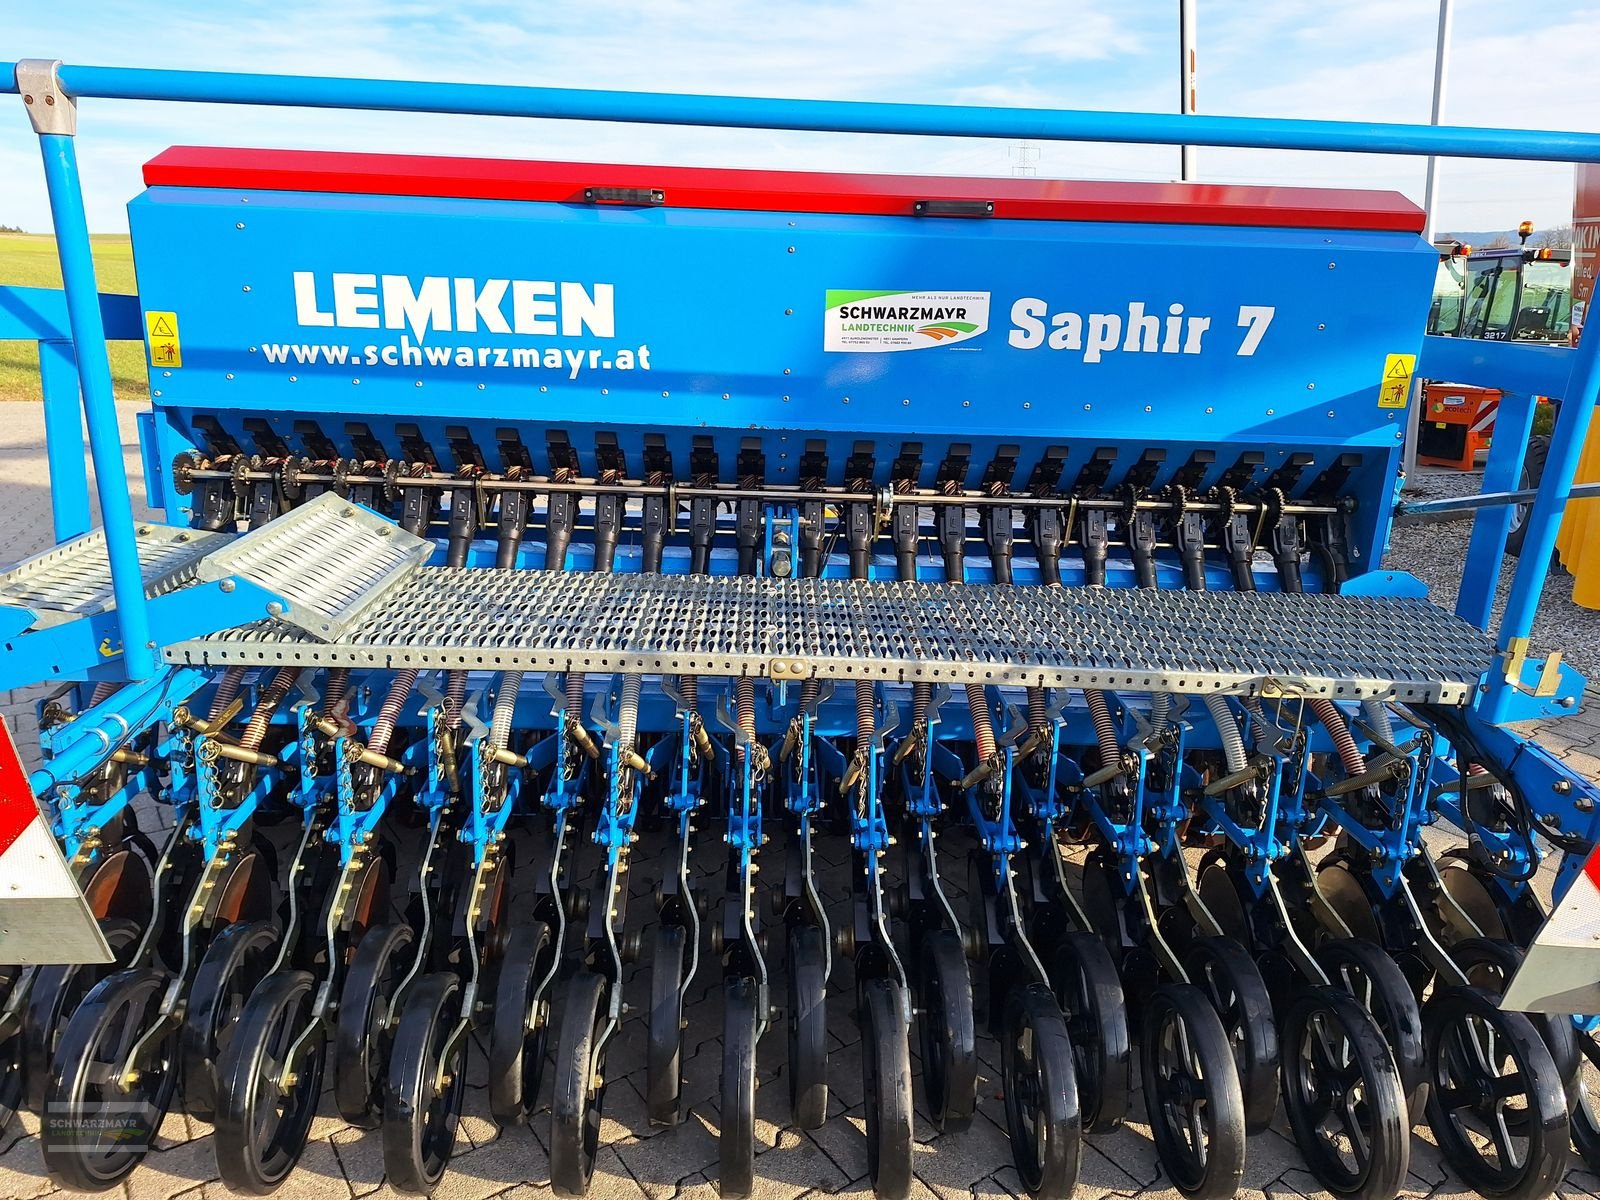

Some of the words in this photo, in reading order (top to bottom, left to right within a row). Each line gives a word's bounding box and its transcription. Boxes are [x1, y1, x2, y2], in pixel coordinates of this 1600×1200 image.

[293, 271, 615, 346] LEMKEN
[839, 306, 967, 320] SCHWARZMAYR
[841, 323, 915, 333] LANDTECHNIK
[1008, 297, 1211, 363] Saphir
[1236, 305, 1276, 356] 7
[1484, 331, 1506, 340] 3217
[261, 335, 651, 379] www.schwarzmayr.at
[1444, 406, 1472, 414] ecotech
